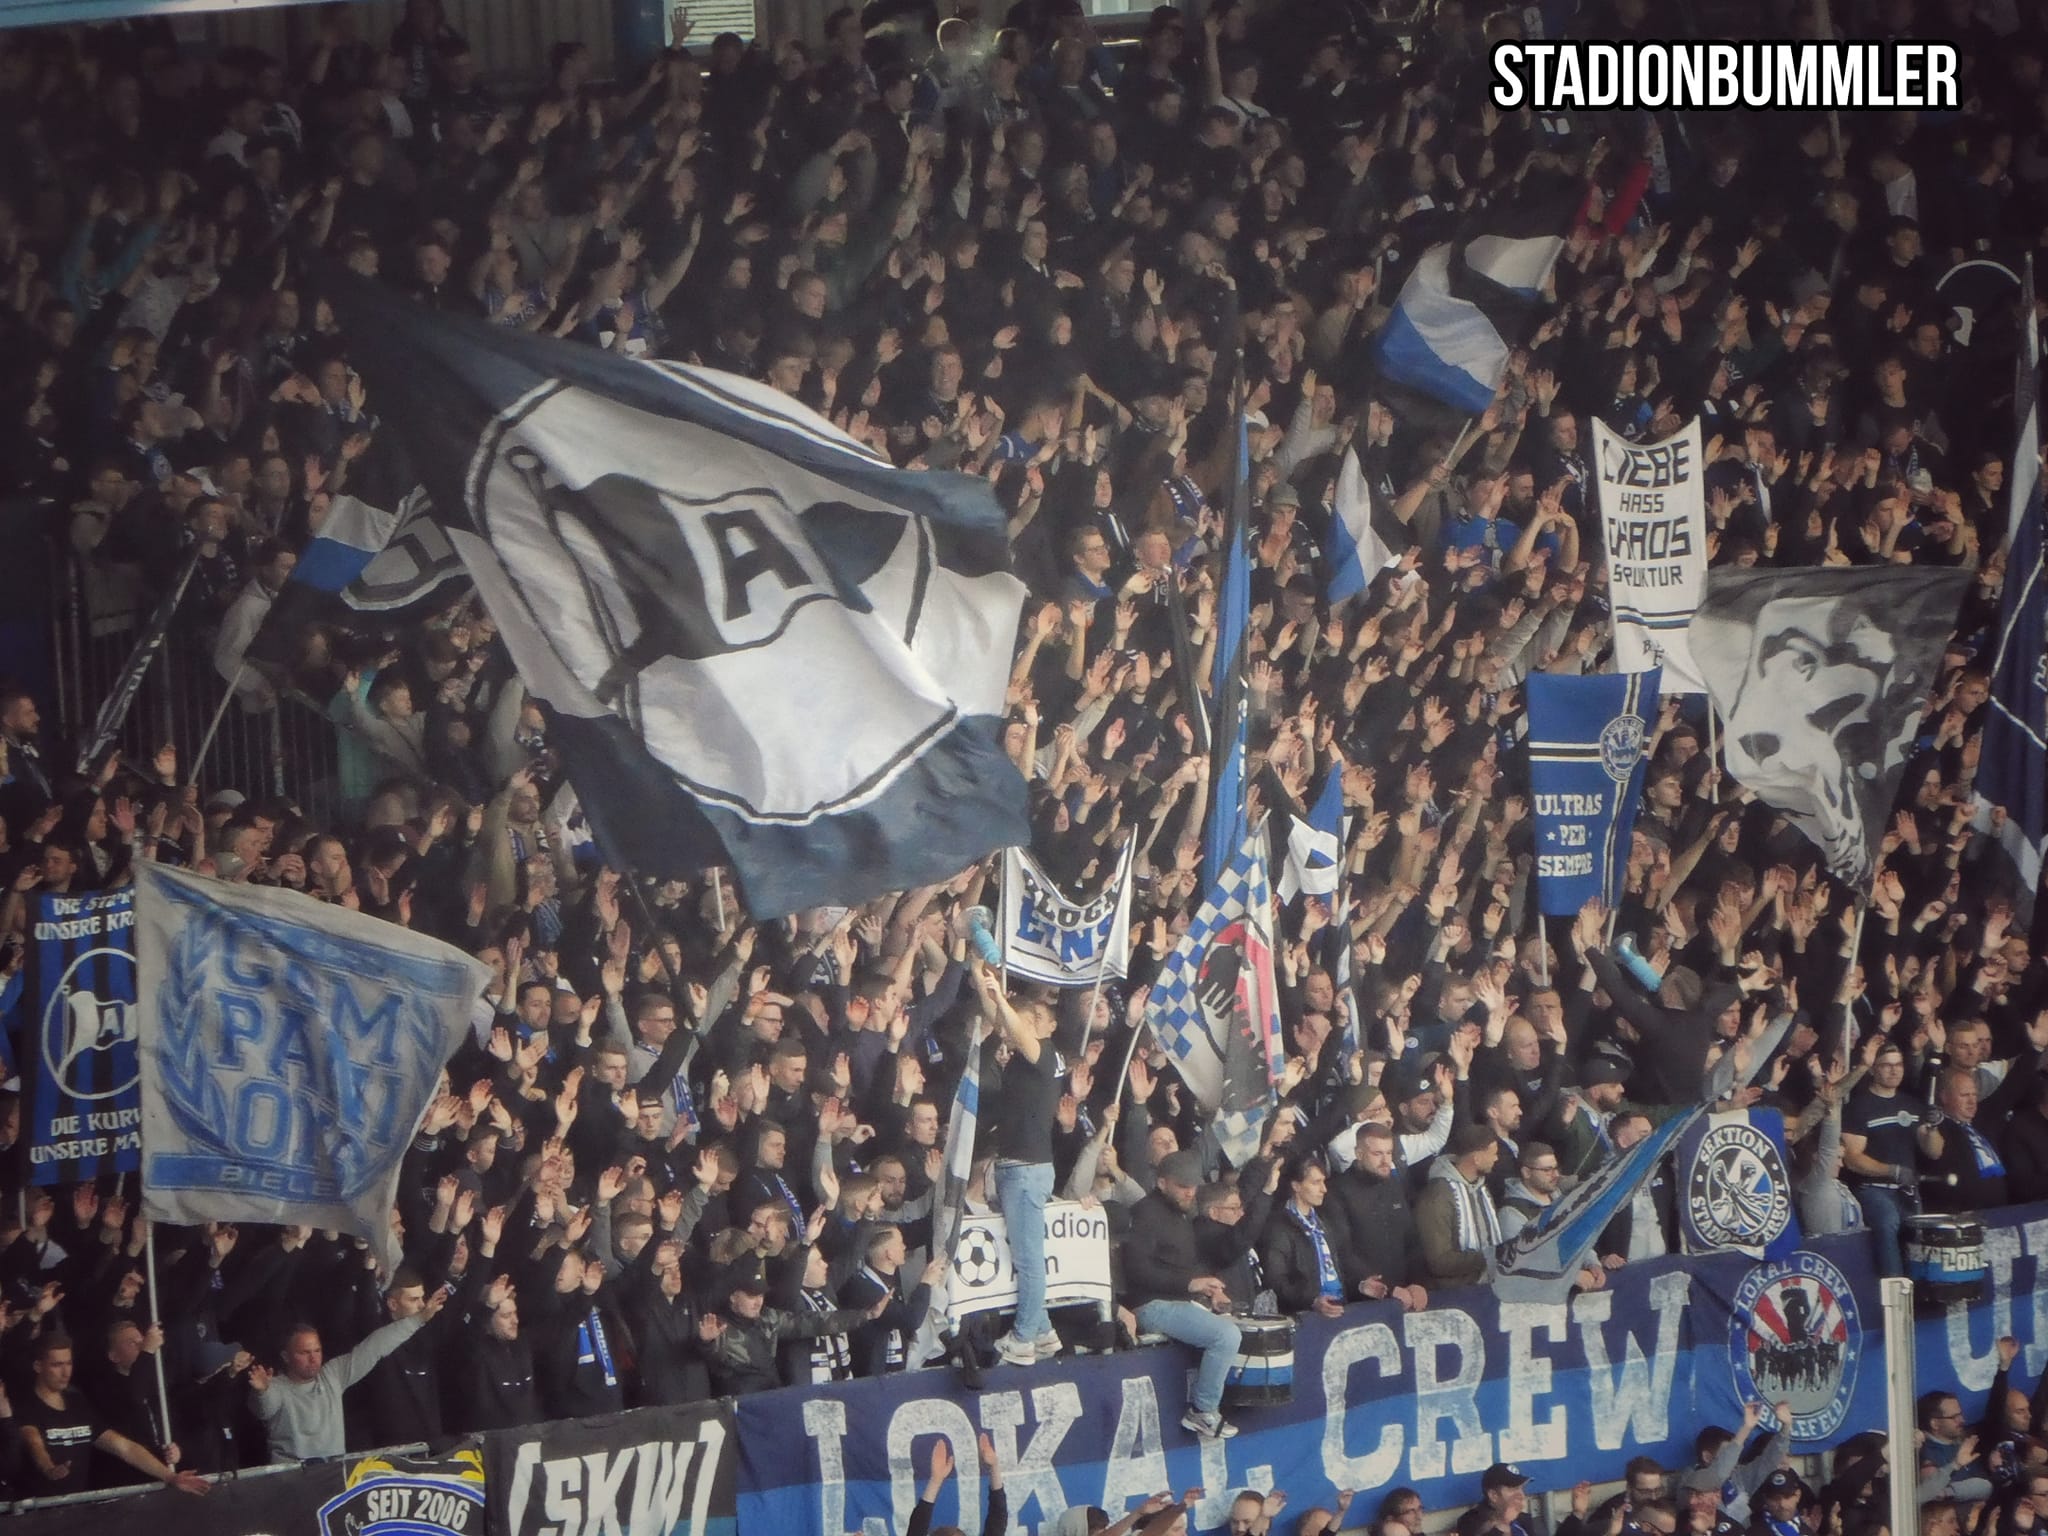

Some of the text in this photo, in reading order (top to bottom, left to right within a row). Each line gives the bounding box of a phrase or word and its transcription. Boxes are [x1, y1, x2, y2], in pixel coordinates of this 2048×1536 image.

[1603, 439, 1690, 488] LIEBE
[1619, 492, 1664, 514] HASS
[1608, 516, 1692, 561] CHAOS
[1534, 794, 1603, 816] ULTRAS
[1559, 824, 1586, 846] PER
[1538, 852, 1593, 877] SEMPRE
[53, 898, 81, 916] DIE
[34, 916, 102, 941] UNSERE
[51, 1115, 81, 1137] DIE
[30, 1131, 141, 1164] UNSERE MA
[1700, 1127, 1771, 1167] SEKTION
[1736, 1255, 1849, 1312] LOKAL CREW
[802, 1271, 1692, 1536] LOKAL CREW
[367, 1488, 471, 1532] SEIT 2006
